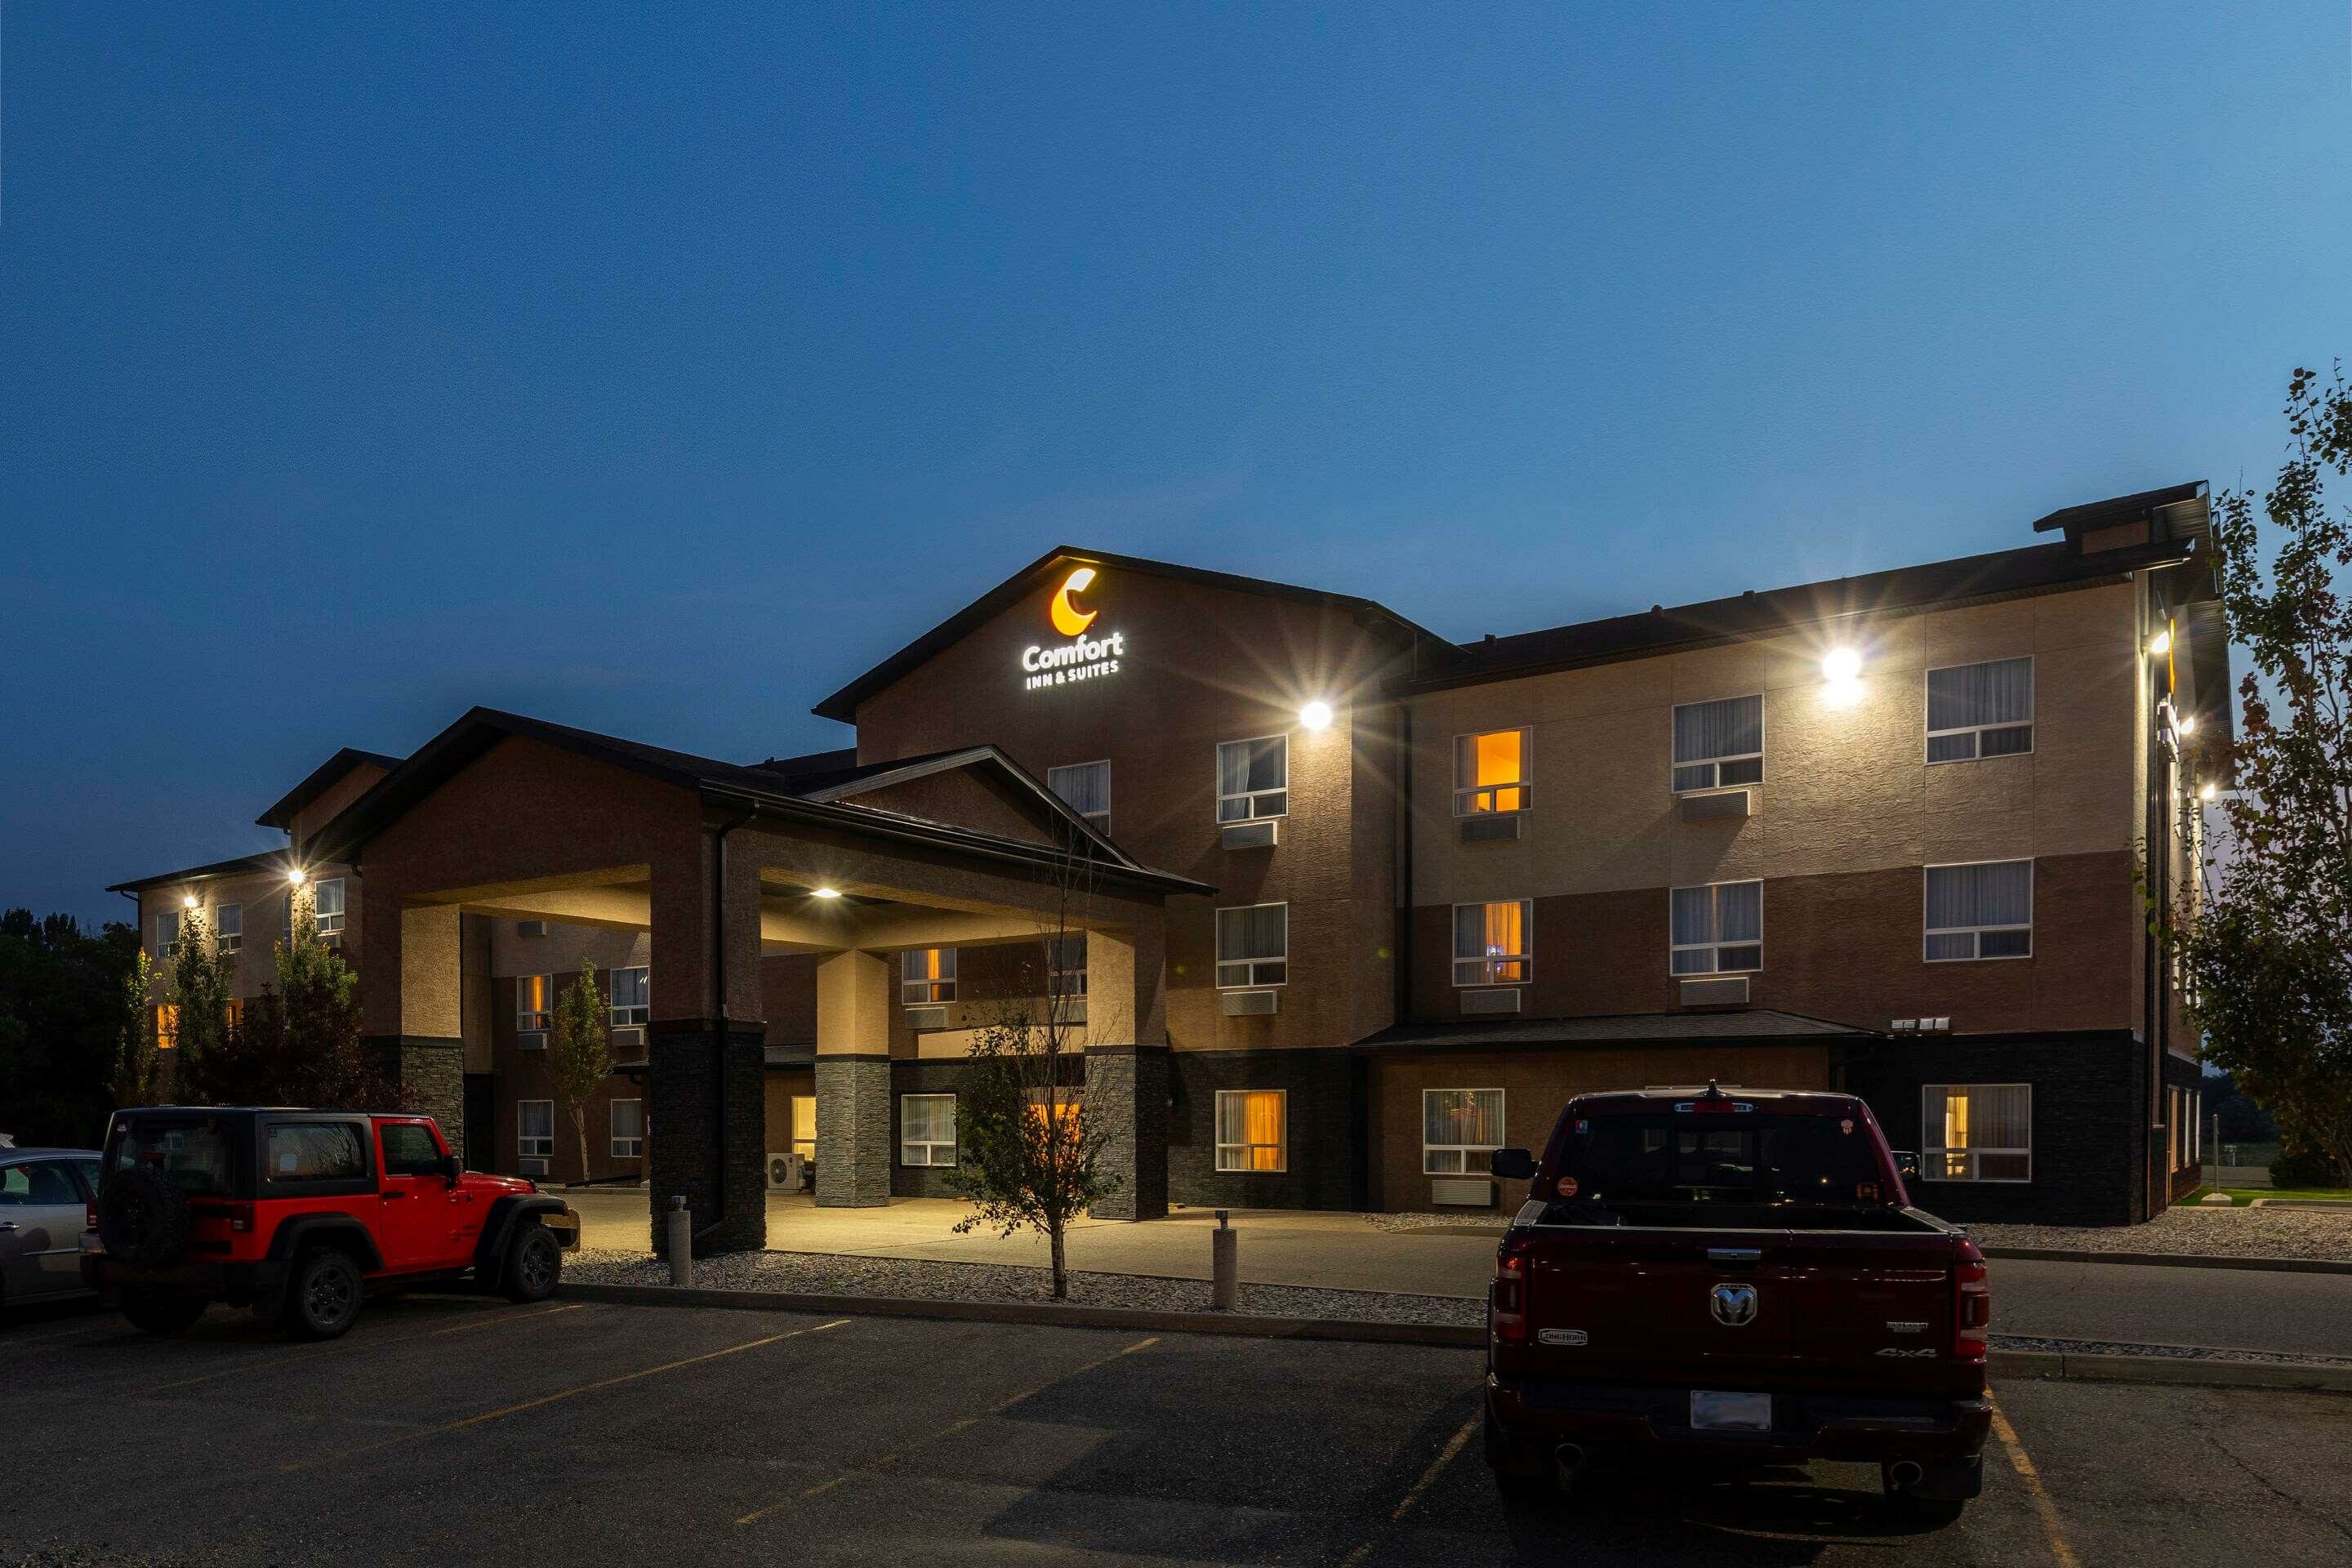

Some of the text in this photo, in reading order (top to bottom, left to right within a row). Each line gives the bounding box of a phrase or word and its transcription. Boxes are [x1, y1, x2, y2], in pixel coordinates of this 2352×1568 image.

[1022, 632, 1123, 672] Comfort
[1026, 660, 1119, 690] INN & SUITES
